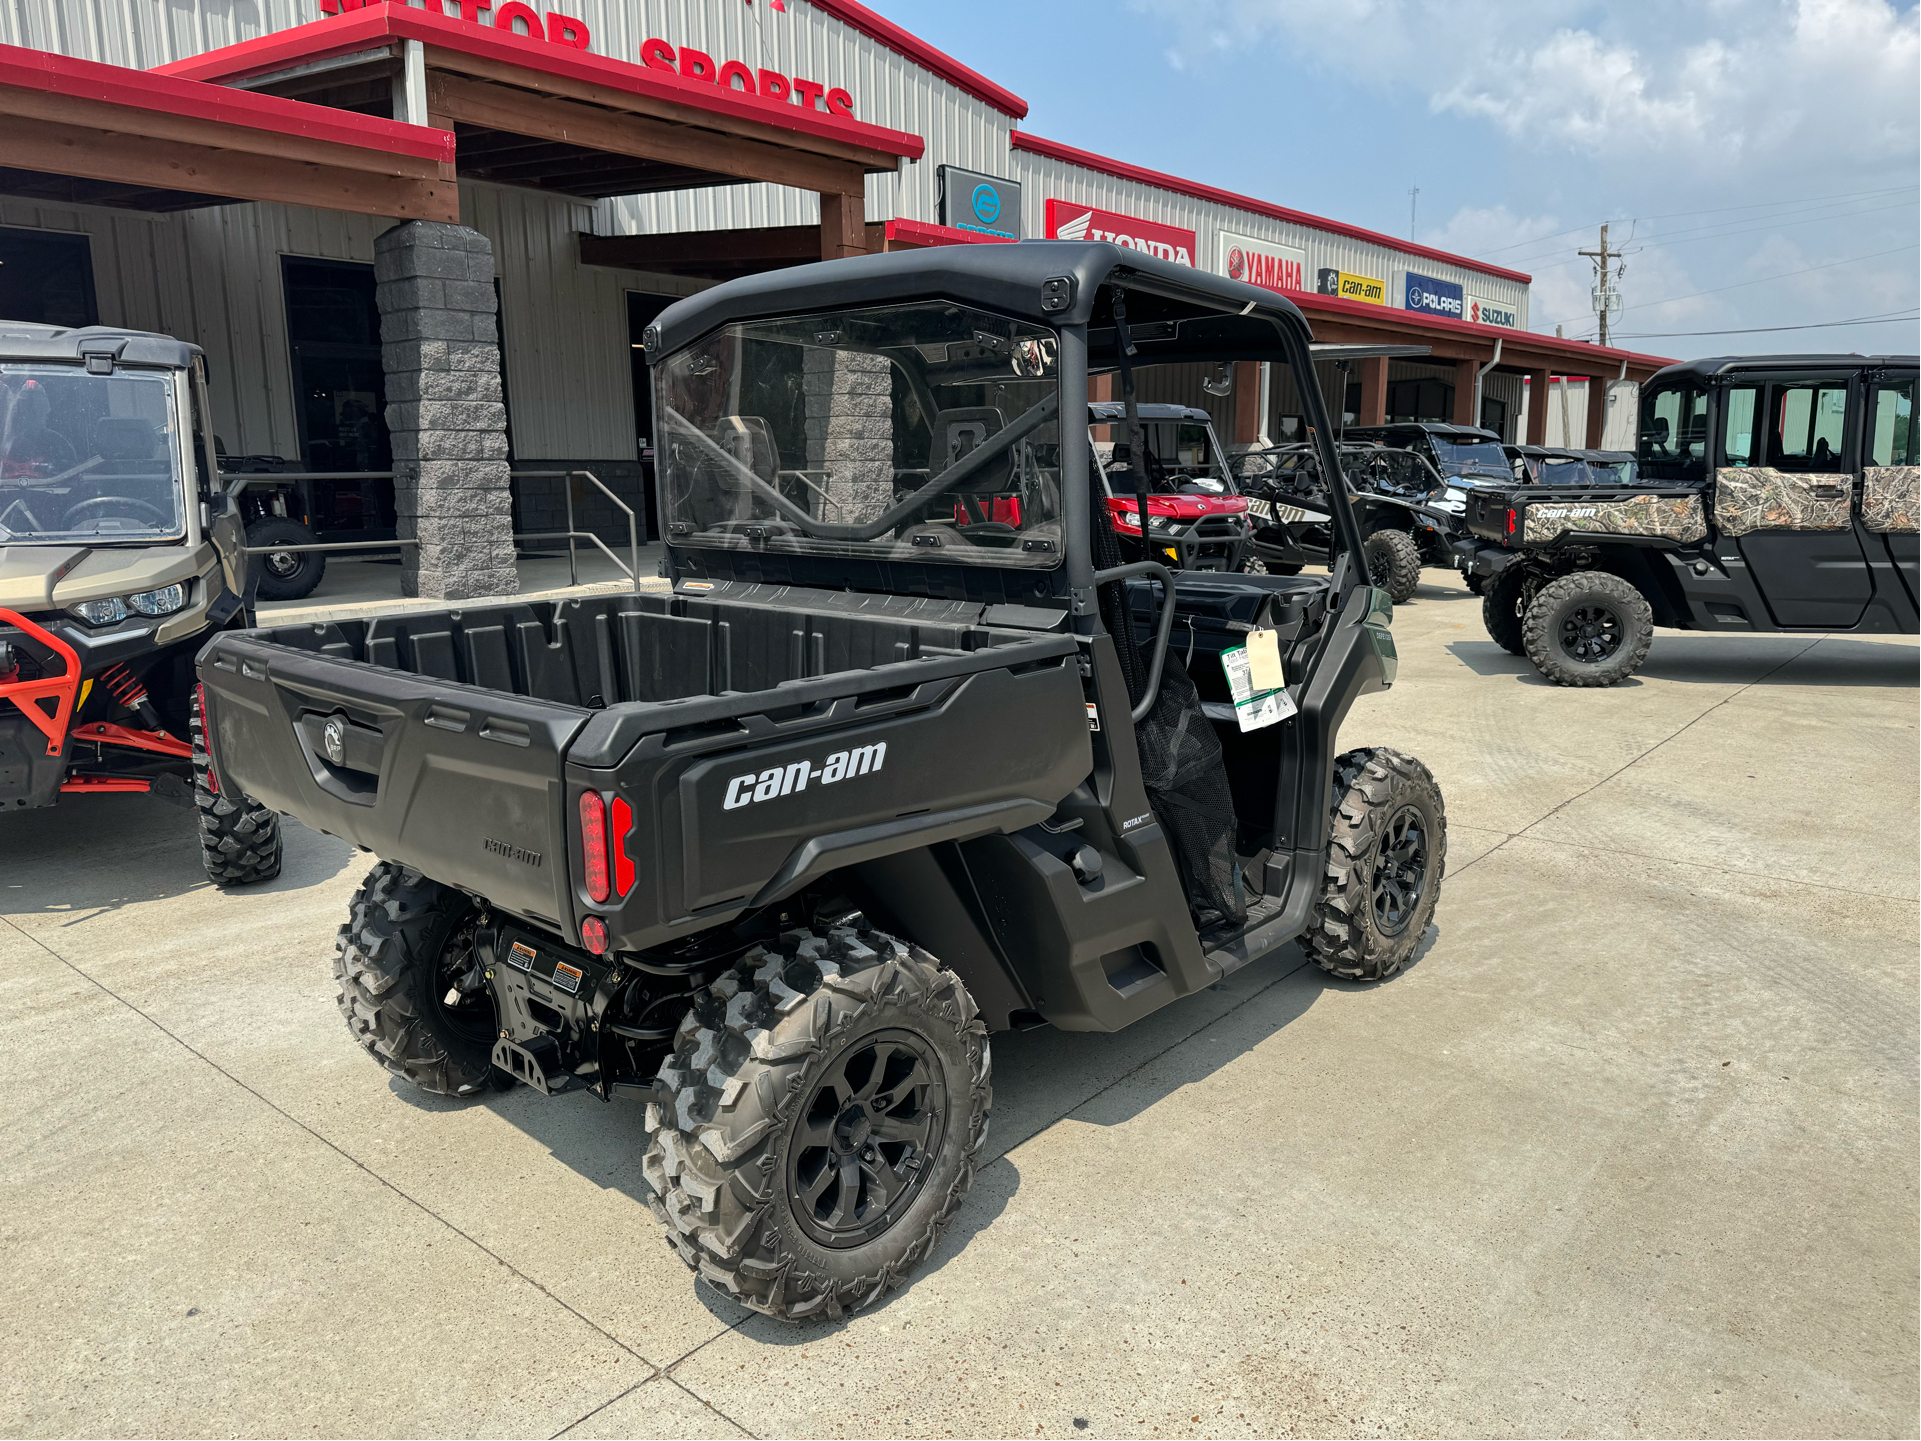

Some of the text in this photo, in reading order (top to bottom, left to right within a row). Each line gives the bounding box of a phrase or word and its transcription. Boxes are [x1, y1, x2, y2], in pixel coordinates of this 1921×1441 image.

[640, 37, 855, 120] SPORTS
[1245, 250, 1302, 291] YAMAHA
[1341, 279, 1382, 300] can-am
[1422, 292, 1462, 314] POLARIS
[1481, 306, 1515, 328] SUZUKI
[1537, 508, 1596, 518] can-am
[723, 742, 887, 810] can-am
[1123, 815, 1143, 830] ROTAX
[483, 836, 542, 868] can-am
